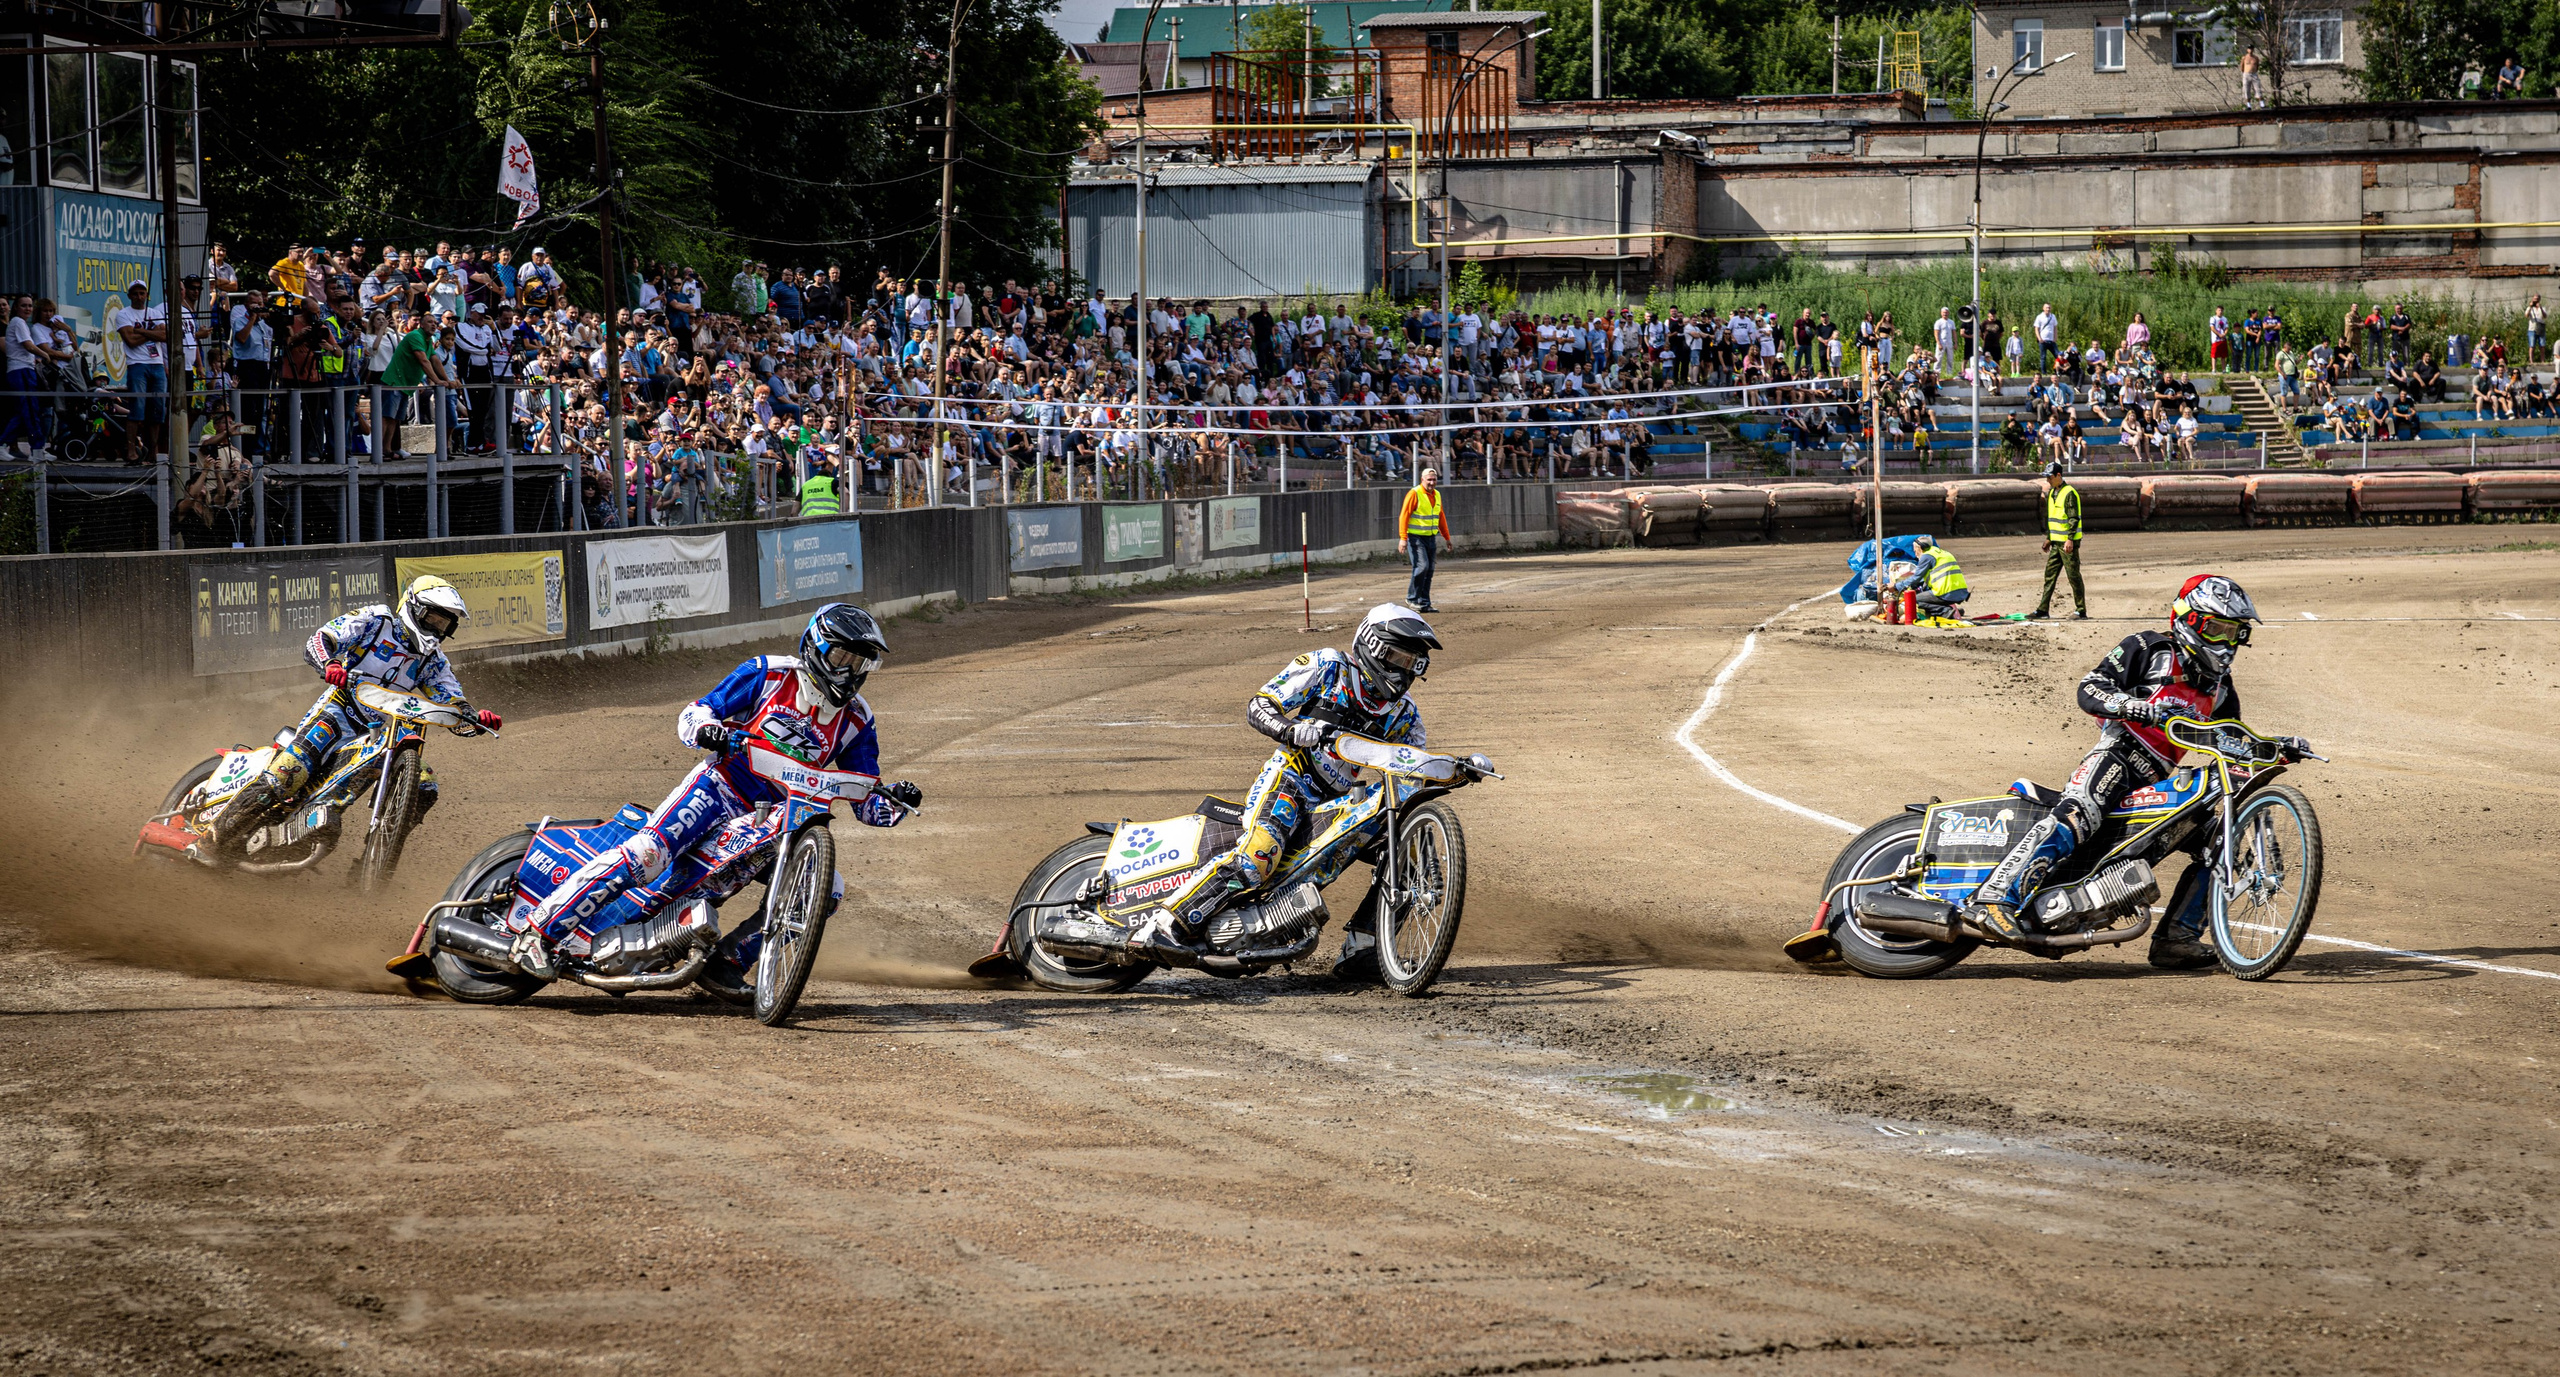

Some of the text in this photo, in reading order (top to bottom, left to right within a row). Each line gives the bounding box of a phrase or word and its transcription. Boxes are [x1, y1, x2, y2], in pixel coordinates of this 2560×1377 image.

[59, 202, 114, 249] ДОСААФ
[285, 577, 321, 602] КАНКУН
[345, 573, 379, 597] КАНКУН
[475, 569, 513, 591] ОРГАНИЗАЦИЯ
[513, 568, 535, 586] ОХРАНЫ
[217, 581, 258, 606] КАНКУН
[632, 587, 652, 604] ГОРОДА
[652, 584, 690, 601] НОВОСИБИРСКА
[218, 611, 259, 636] ТРЕВЕЛ
[286, 605, 322, 630] ТРЕВЕЛ
[494, 596, 533, 626] «ПЧЕЛА»
[766, 704, 801, 720] АЛТЫН
[759, 716, 823, 760] СТК
[811, 724, 830, 753] МОТО
[781, 771, 841, 796] MEGA LADA
[665, 788, 715, 841] MEGA
[1951, 818, 2005, 833] УРАЛ
[2015, 824, 2047, 854] Brandt
[526, 849, 557, 874] MEGA
[1110, 849, 1180, 878] ФОСАГРО
[1106, 871, 1196, 906] СК "ТУРБИН
[559, 876, 624, 930] LADA
